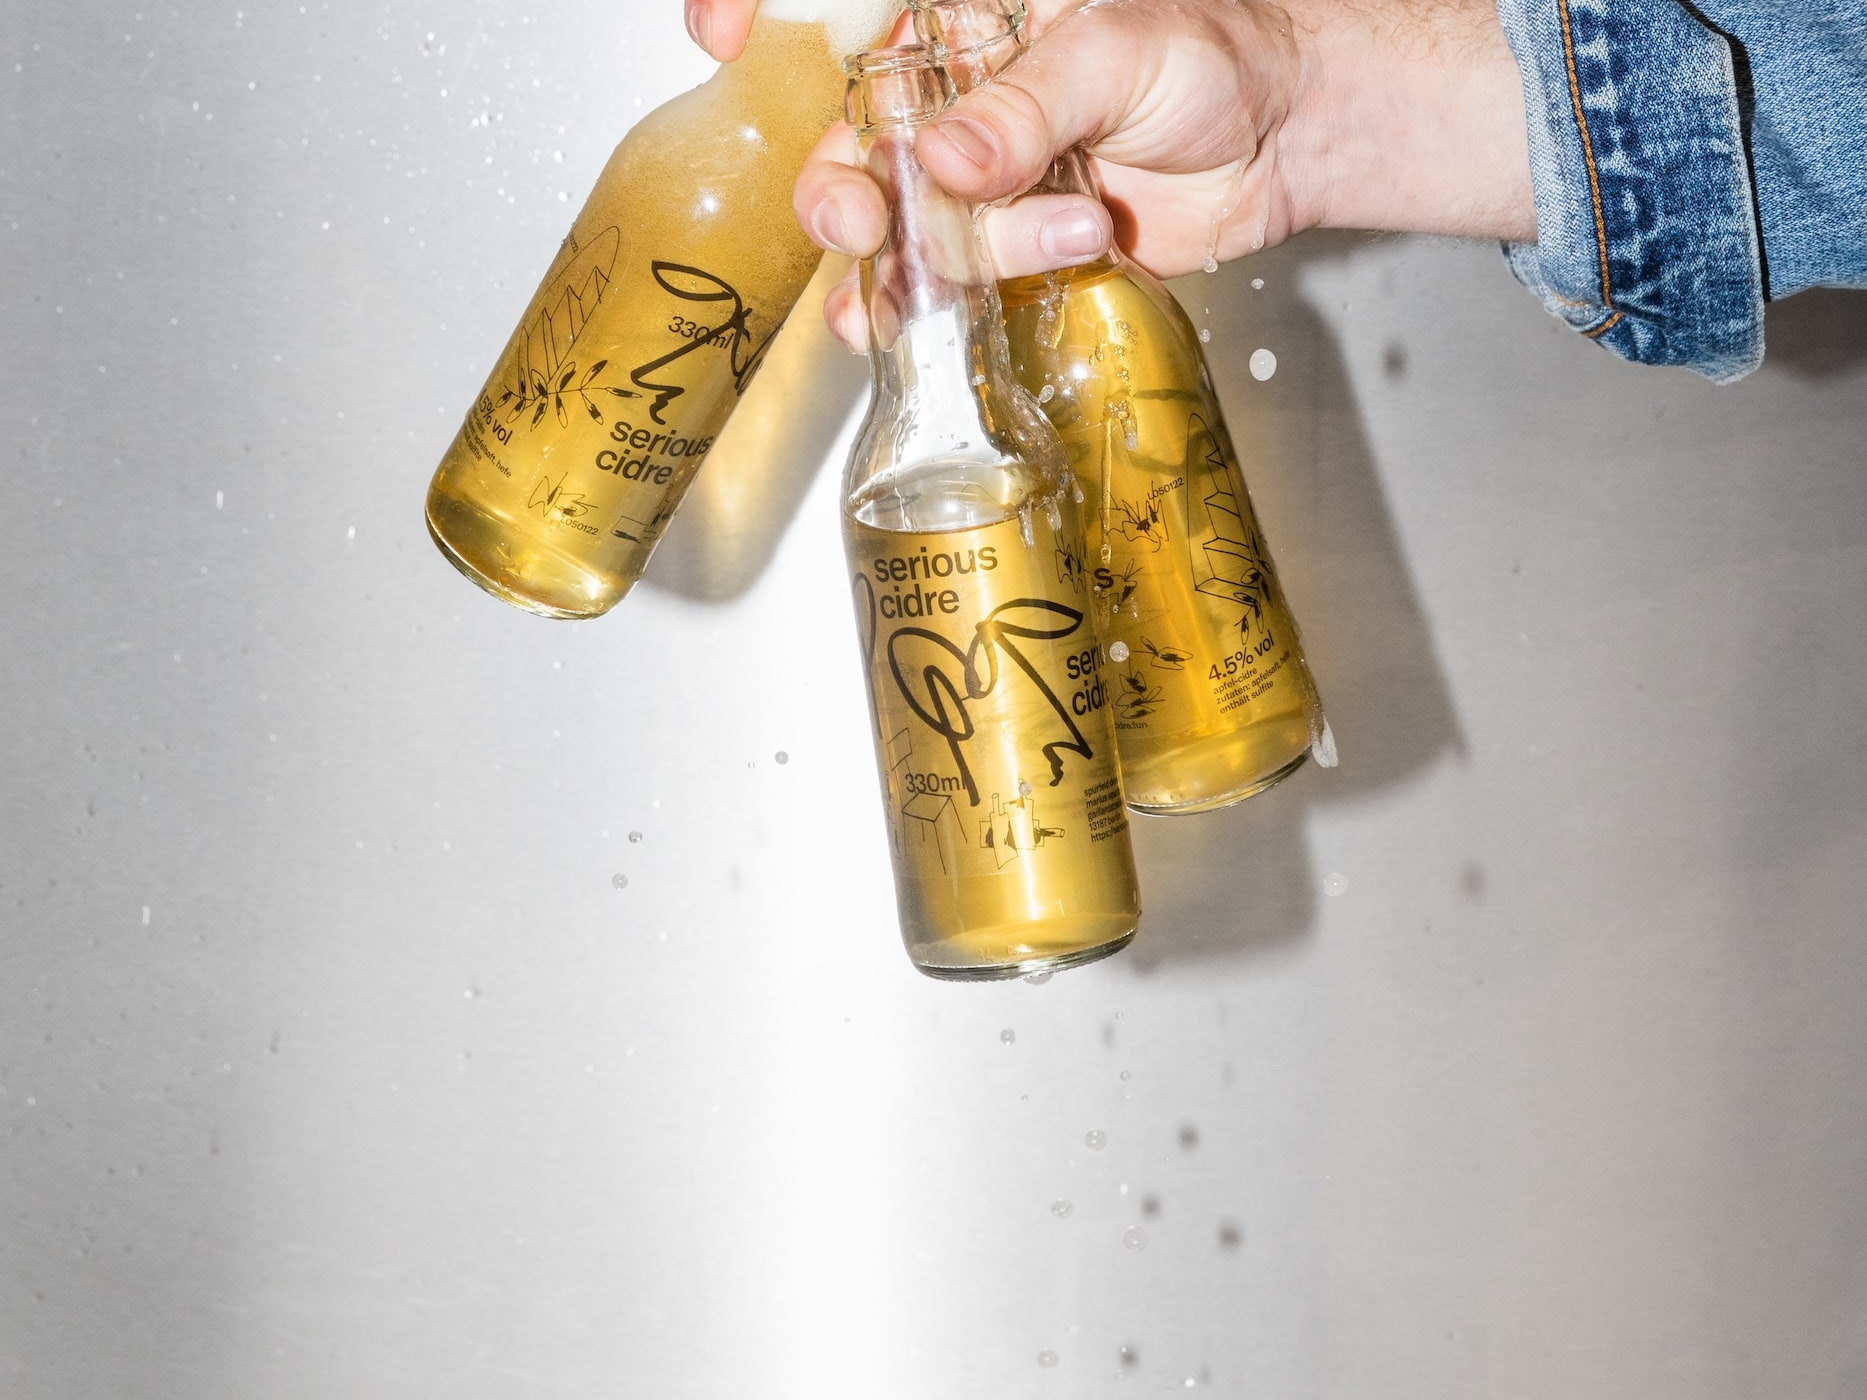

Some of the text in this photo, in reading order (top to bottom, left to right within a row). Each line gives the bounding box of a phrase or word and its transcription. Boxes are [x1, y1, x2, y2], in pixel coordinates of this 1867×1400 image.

[492, 419, 513, 447] vol
[610, 421, 714, 457] serious
[496, 459, 512, 479] hefe
[595, 449, 673, 486] cidre
[1147, 477, 1185, 501] L050122
[874, 546, 999, 583] serious
[879, 583, 961, 620] cidre
[1208, 629, 1275, 681] 4.5% vol
[1213, 667, 1258, 696] apfel-cidre
[1216, 683, 1251, 706] zutaten:
[1220, 680, 1275, 715] enthält sulfite
[1089, 817, 1107, 832] 13187
